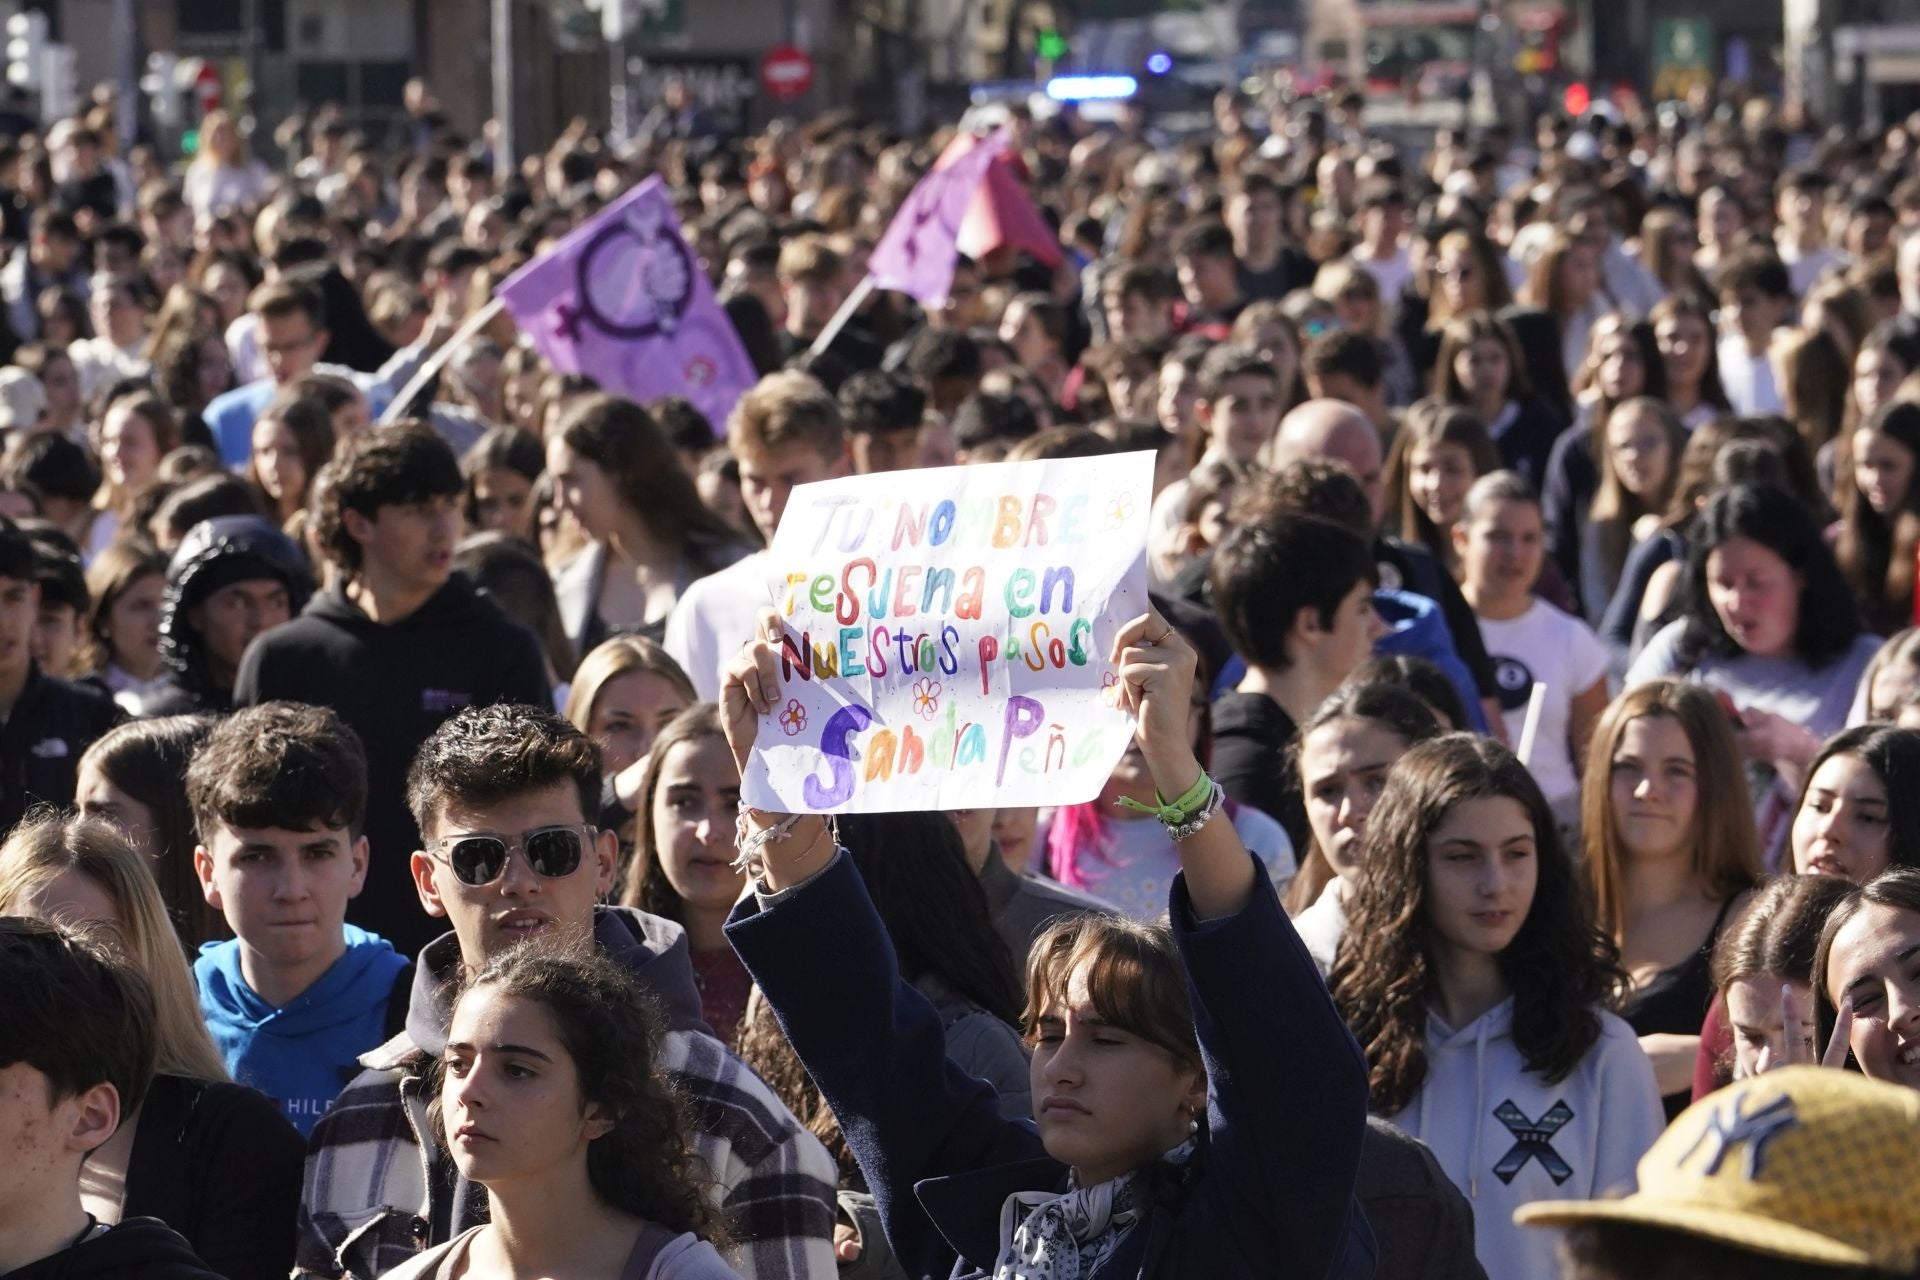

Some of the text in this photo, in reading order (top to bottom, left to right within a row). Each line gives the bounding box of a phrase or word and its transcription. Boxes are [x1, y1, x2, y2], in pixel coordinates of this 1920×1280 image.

[812, 493, 1089, 557] TU NOMBRE
[1004, 566, 1074, 618] en
[803, 695, 1105, 810] Sandra Peña
